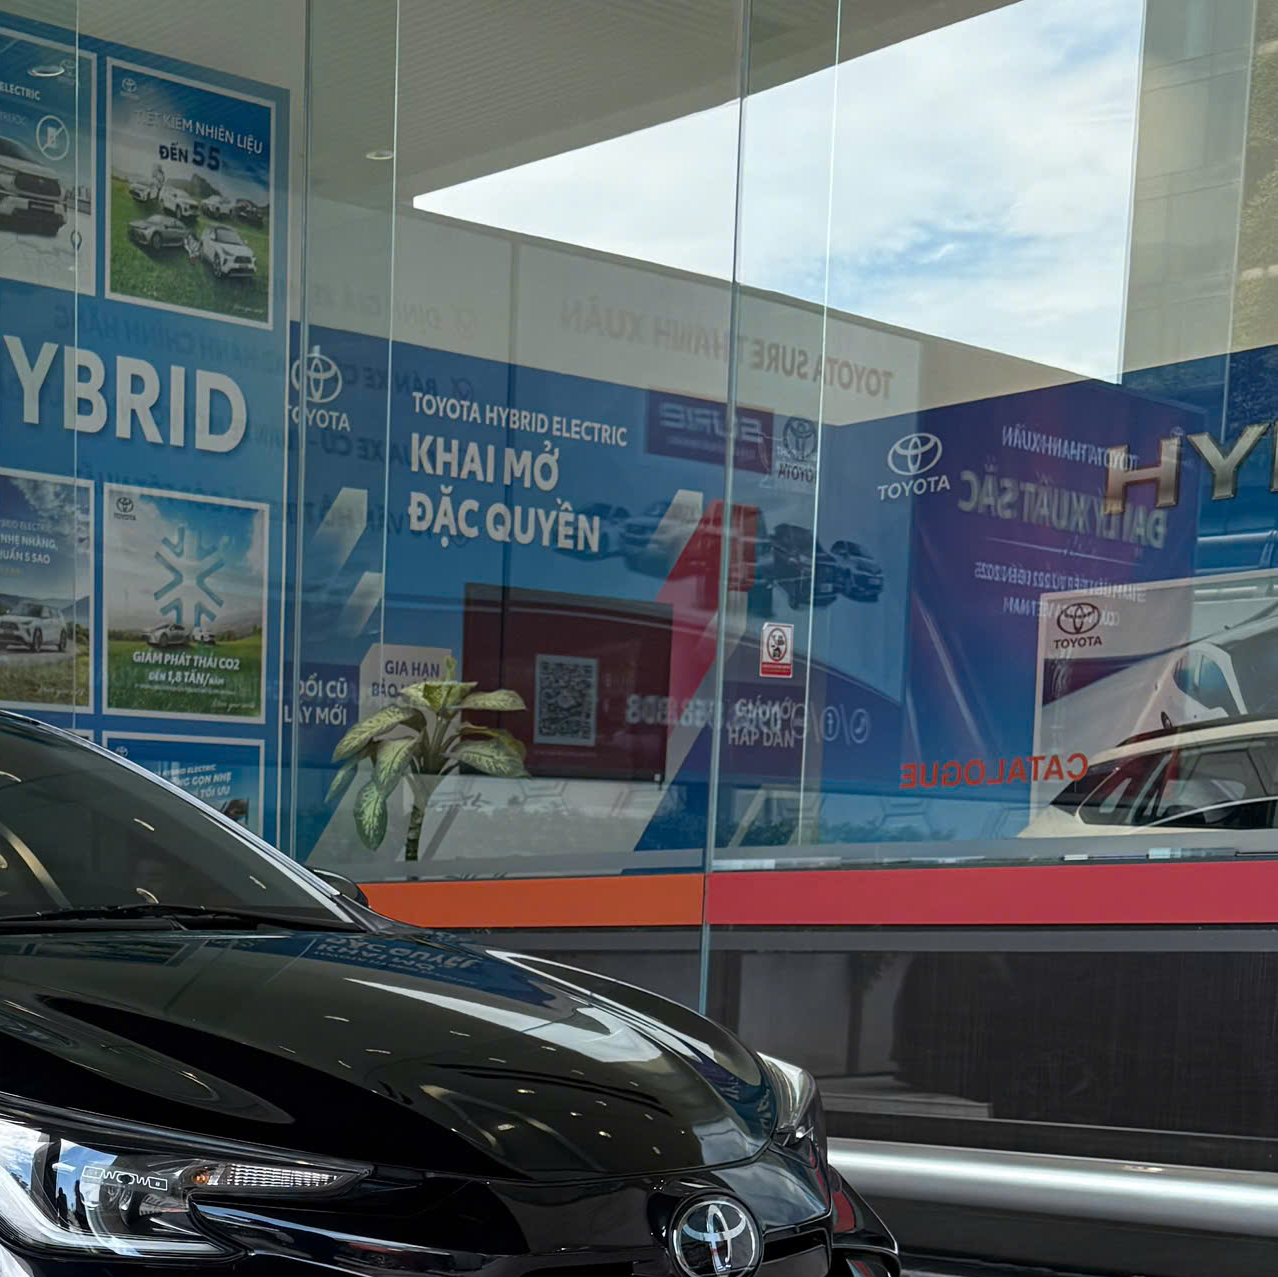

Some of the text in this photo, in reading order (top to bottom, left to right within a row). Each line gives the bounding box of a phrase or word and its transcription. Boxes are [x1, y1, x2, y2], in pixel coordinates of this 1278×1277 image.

[0, 81, 41, 101] ELECTRIC
[195, 120, 234, 145] NHIÊN
[236, 133, 263, 155] LIỆU
[159, 142, 188, 163] ĐẾN
[412, 392, 627, 447] TOYOTA HYBRID ELECTRIC
[411, 434, 495, 480] KHAI
[504, 440, 560, 491] MỞ
[1104, 419, 1278, 515] HY
[878, 476, 950, 501] TOYOTA
[409, 483, 479, 549] ĐẶC
[486, 498, 600, 553] QUYỀN
[31, 553, 52, 565] SAO
[1053, 635, 1103, 649] TOYOTA
[163, 652, 190, 667] PHÁT
[385, 660, 409, 676] GIA
[326, 677, 348, 699] CŨ
[316, 704, 347, 726] MỚI
